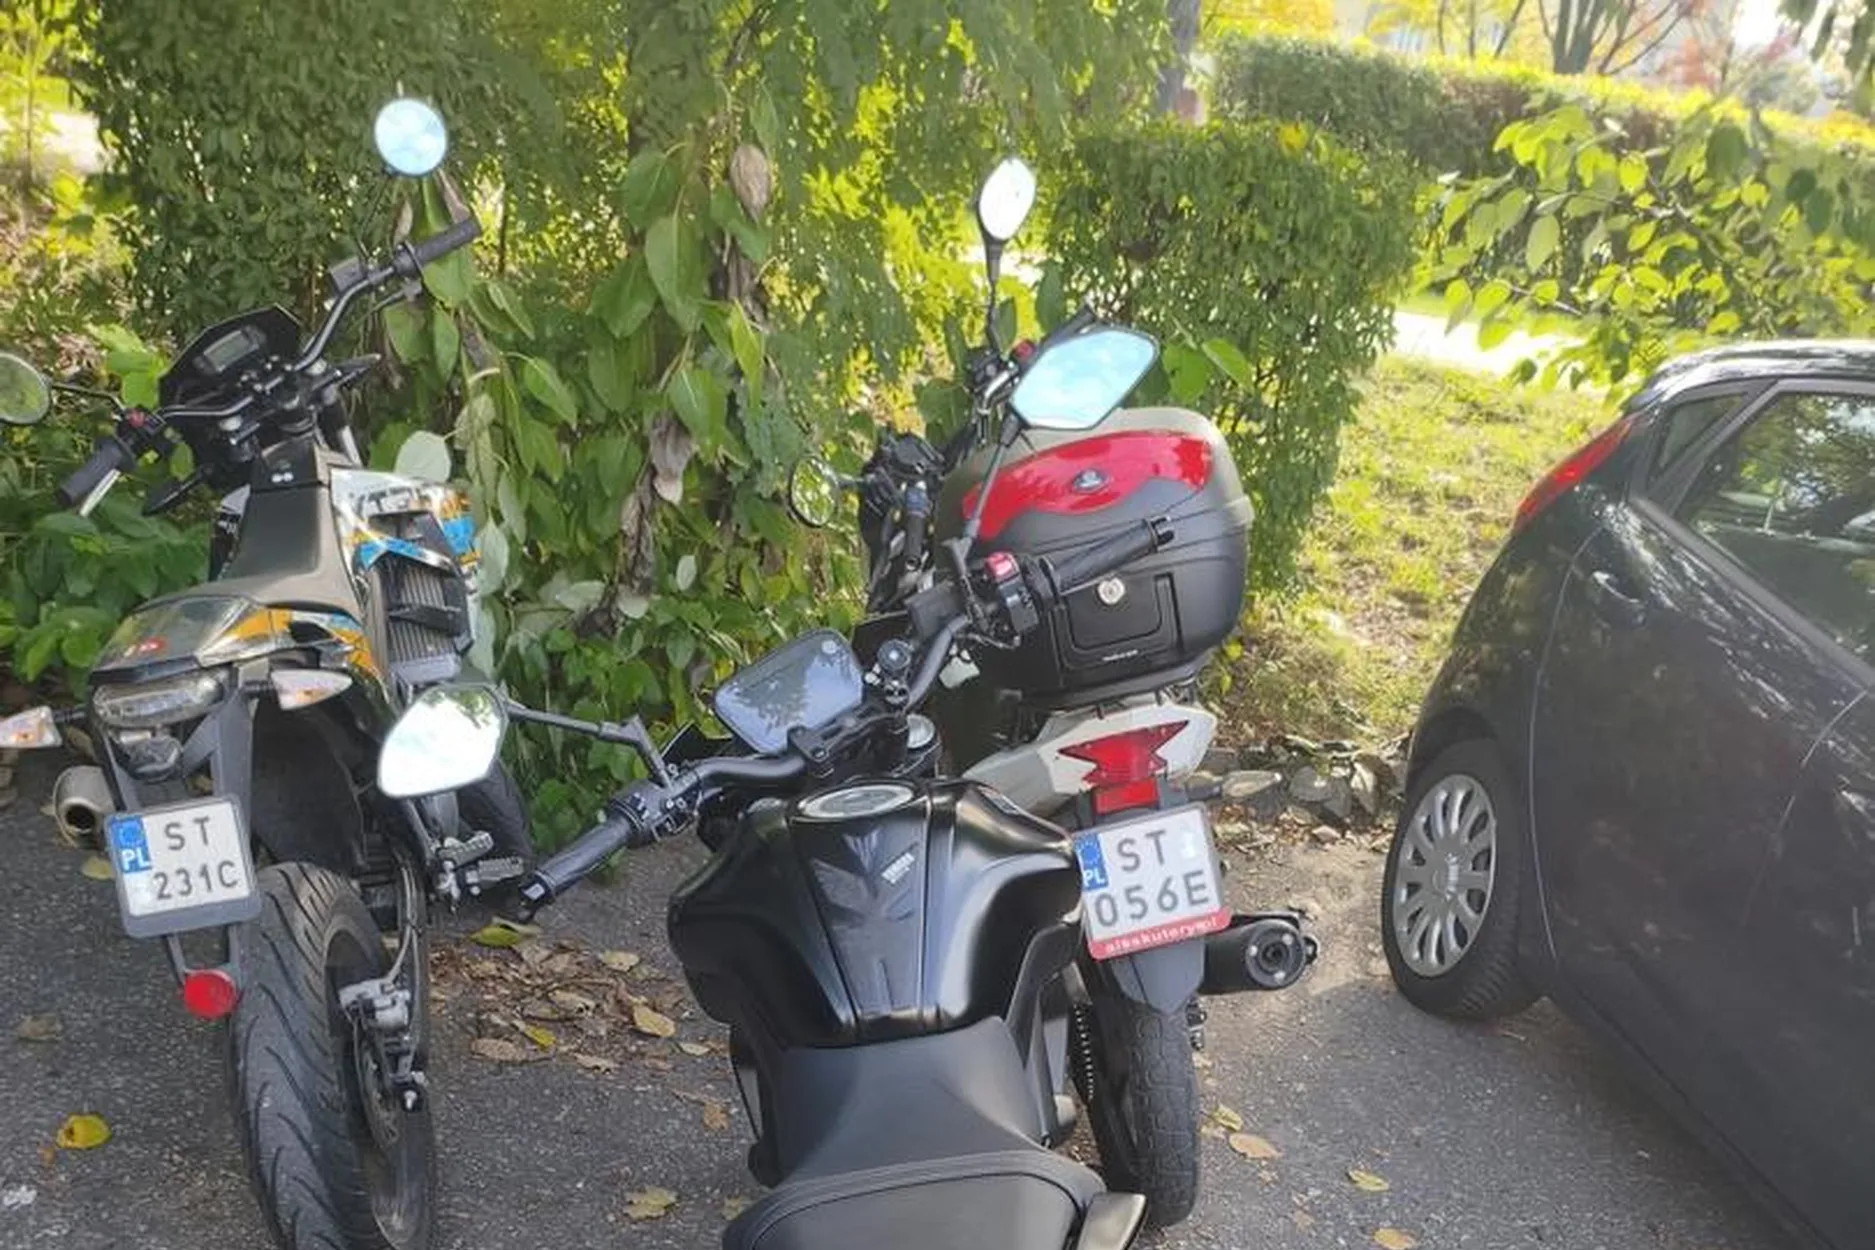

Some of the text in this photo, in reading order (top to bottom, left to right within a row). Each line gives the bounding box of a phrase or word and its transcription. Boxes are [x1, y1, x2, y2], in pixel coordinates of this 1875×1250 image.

[164, 816, 210, 851] ST
[1117, 830, 1166, 872] ST
[121, 847, 150, 871] PL
[154, 860, 238, 900] 231C
[1083, 869, 1106, 887] PL
[1094, 870, 1209, 927] 056E
